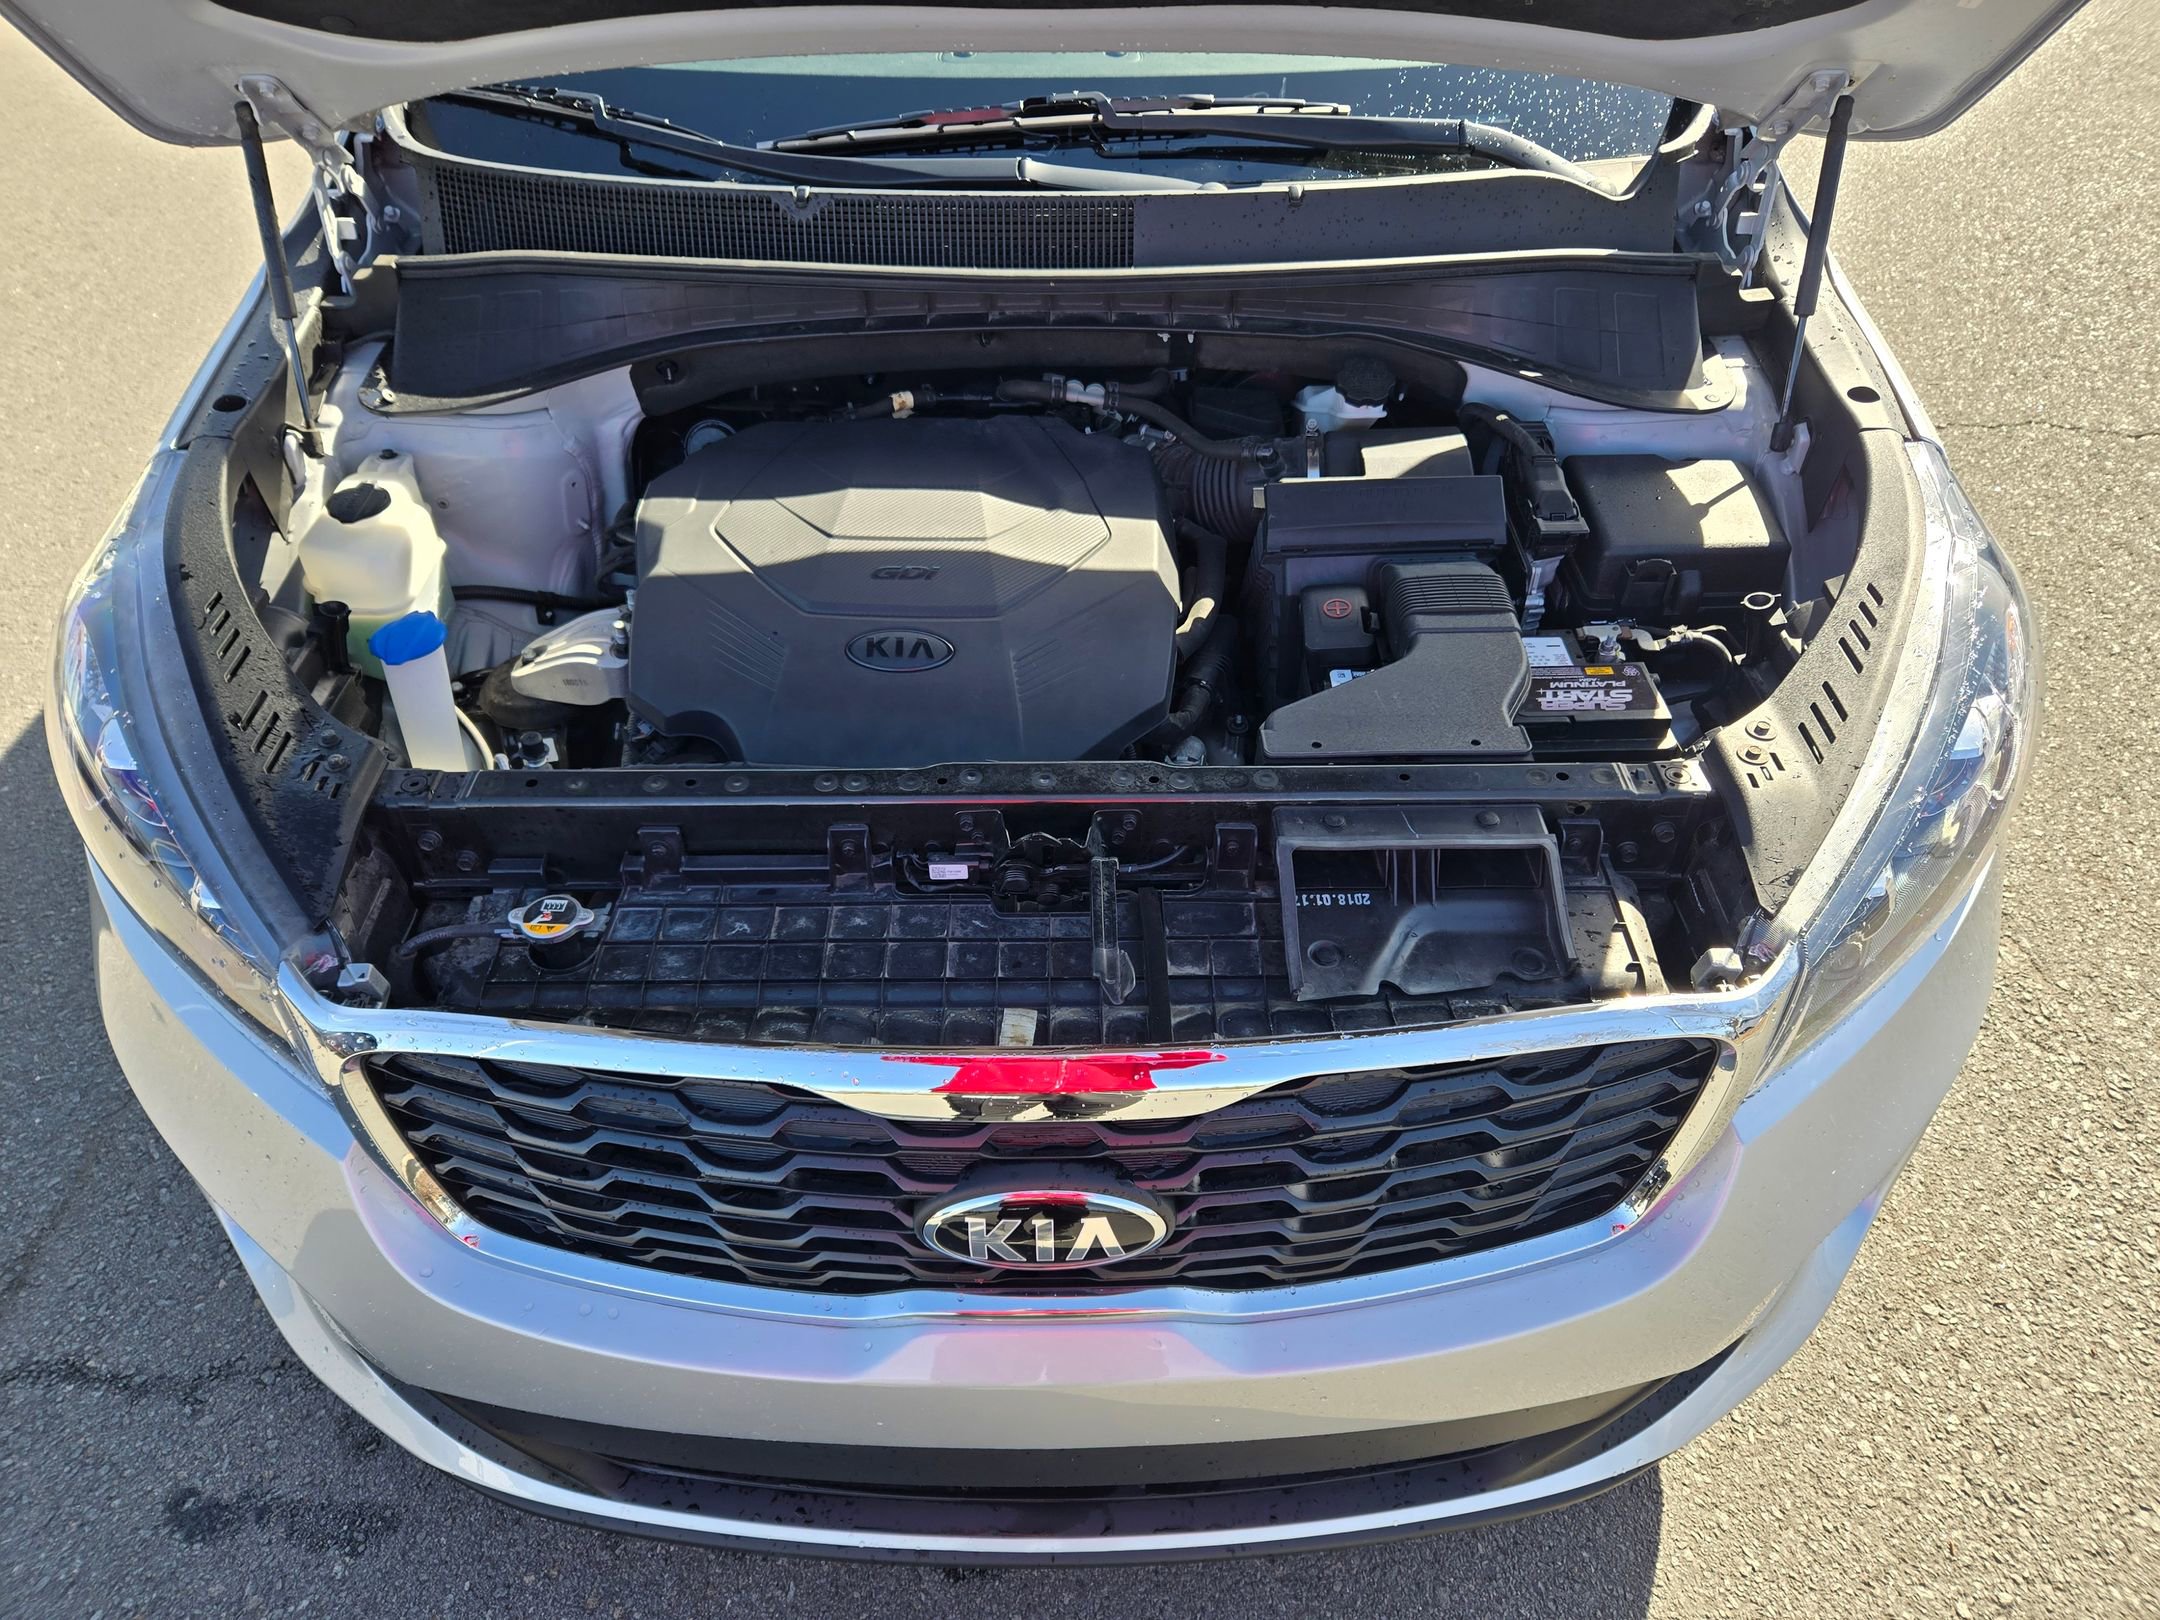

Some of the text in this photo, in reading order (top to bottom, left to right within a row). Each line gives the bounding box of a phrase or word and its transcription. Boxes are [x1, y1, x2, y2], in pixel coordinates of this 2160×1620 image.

[866, 637, 934, 659] KIA
[1550, 680, 1626, 688] PLATINUM
[1540, 689, 1633, 702] START
[1541, 700, 1626, 711] SUPER
[963, 1216, 1127, 1263] KIA
